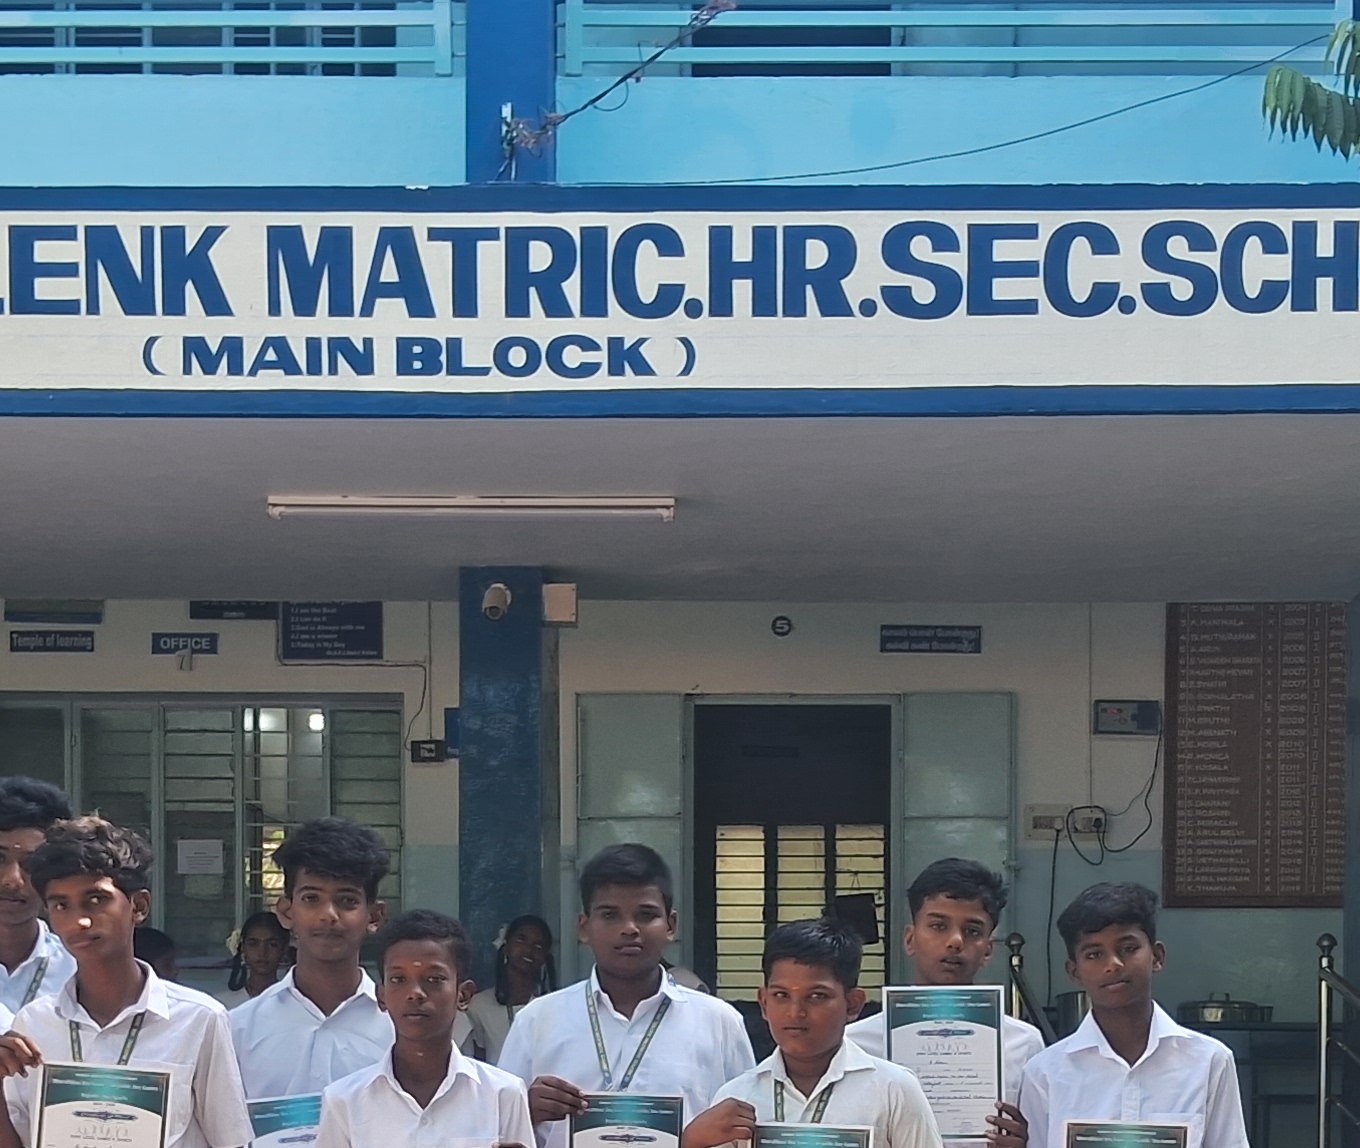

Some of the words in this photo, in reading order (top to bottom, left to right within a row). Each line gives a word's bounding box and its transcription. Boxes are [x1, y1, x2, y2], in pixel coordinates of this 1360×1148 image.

[775, 620, 790, 632] 5
[12, 634, 43, 650] Temple
[46, 634, 55, 646] of
[57, 633, 92, 649] learning
[159, 637, 210, 649] OFFICE
